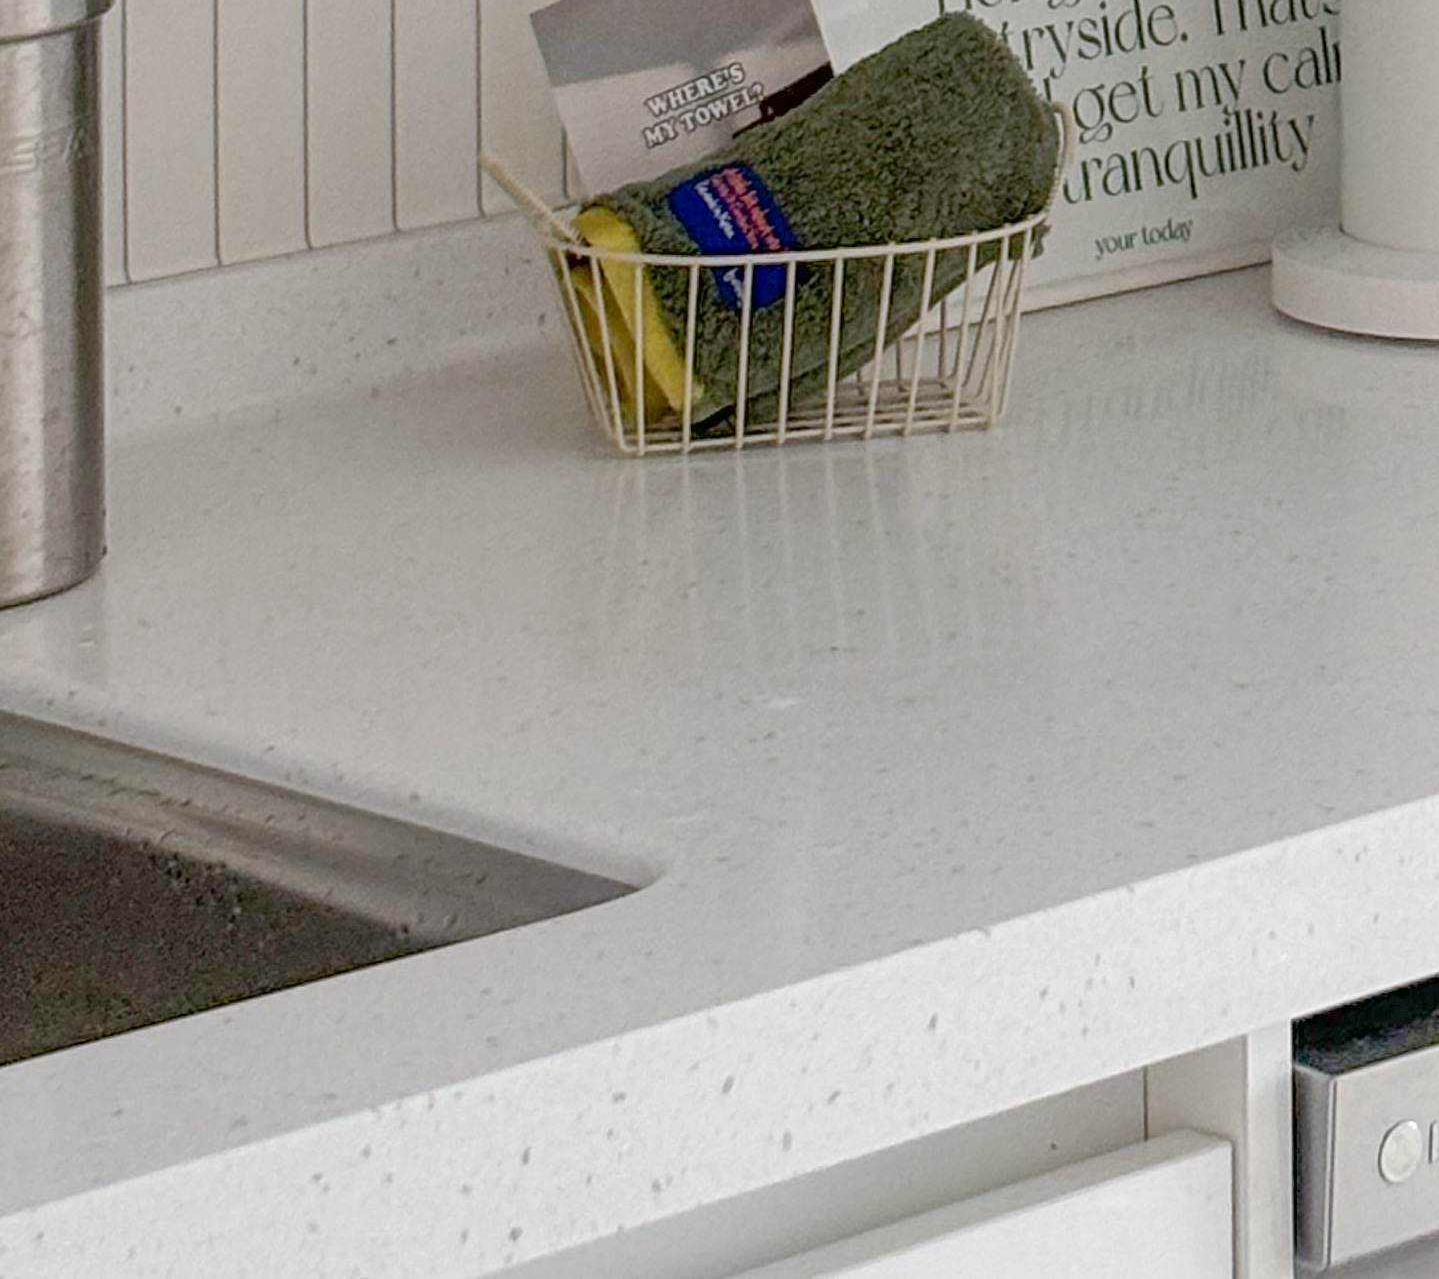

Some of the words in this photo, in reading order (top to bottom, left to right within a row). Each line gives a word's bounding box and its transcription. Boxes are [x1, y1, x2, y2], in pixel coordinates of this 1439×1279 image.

[641, 117, 679, 148] MY
[678, 81, 765, 134] TOWEL?
[643, 61, 746, 117] WHERE'S
[1072, 65, 1165, 145] get
[1174, 59, 1247, 117] my
[1095, 230, 1138, 260] your
[1140, 216, 1194, 243] today
